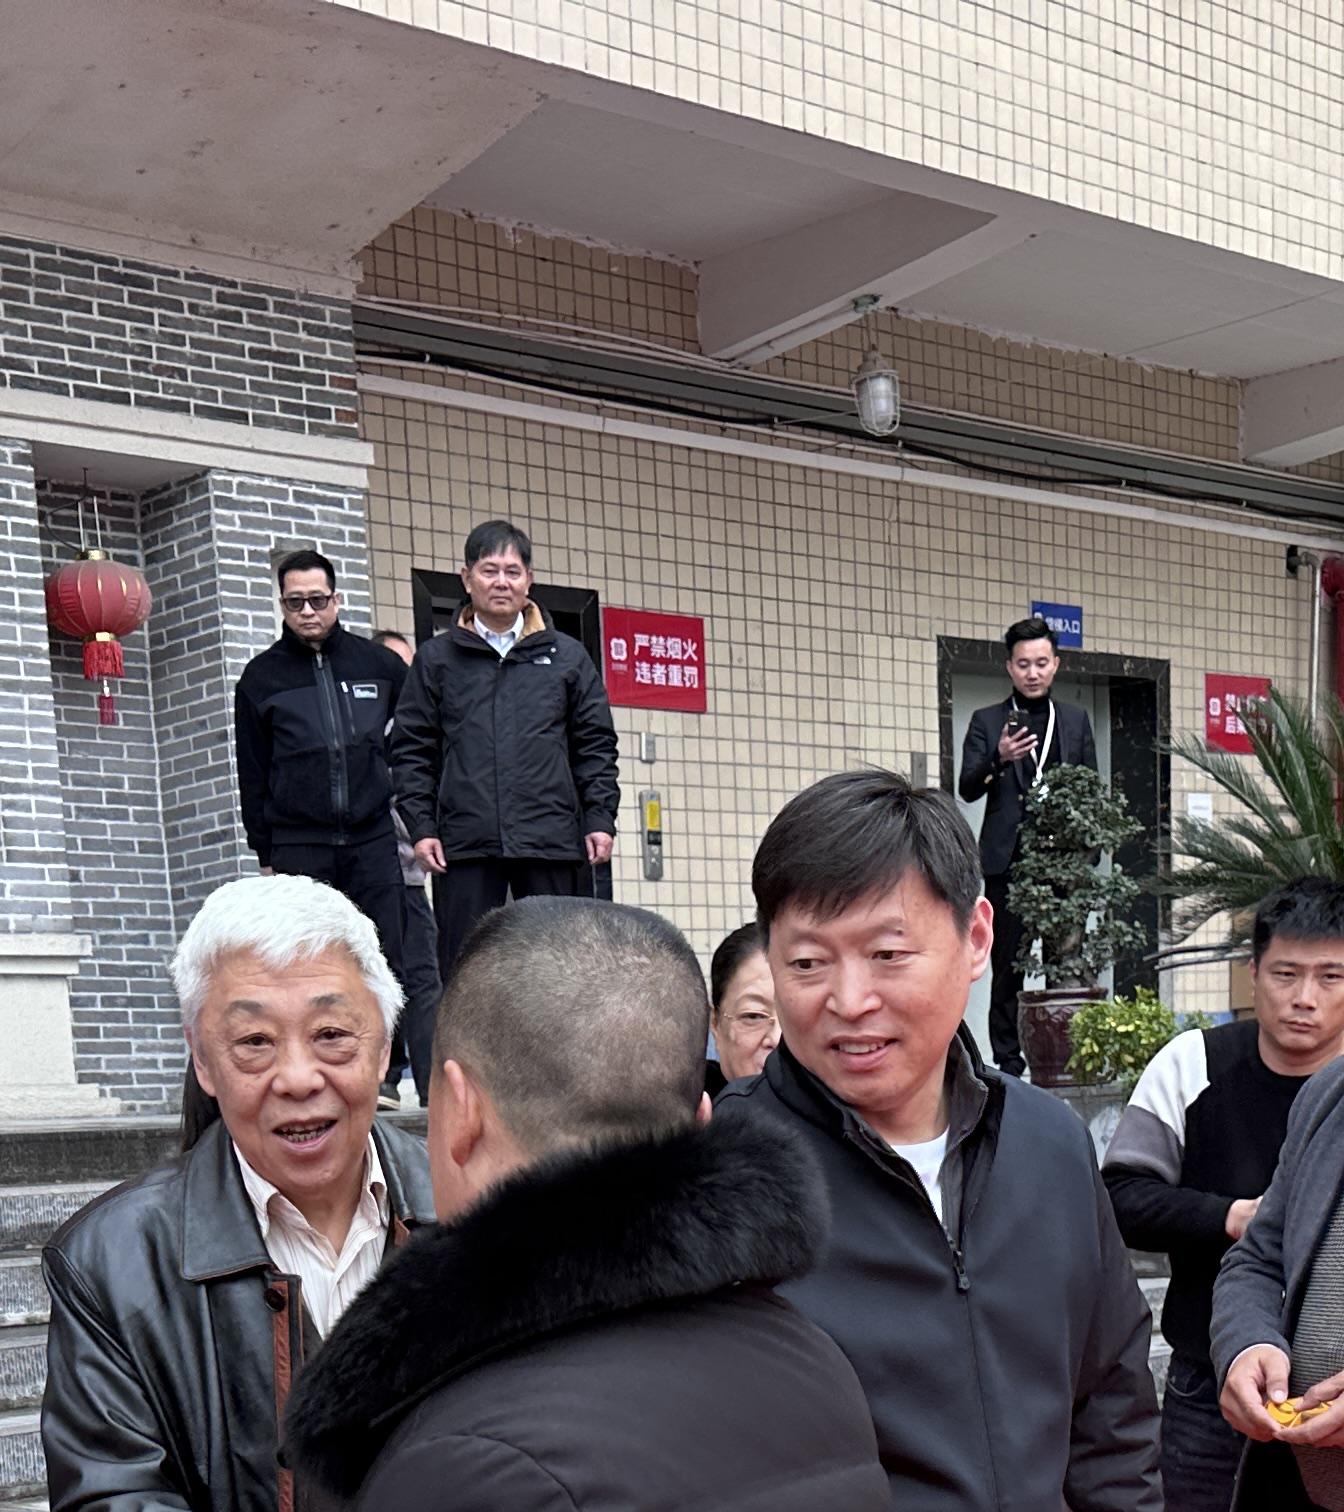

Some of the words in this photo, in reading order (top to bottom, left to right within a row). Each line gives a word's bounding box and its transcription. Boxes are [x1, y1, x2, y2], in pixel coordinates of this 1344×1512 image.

[634, 633, 698, 662] 严禁烟火
[635, 660, 698, 689] 违者重罚
